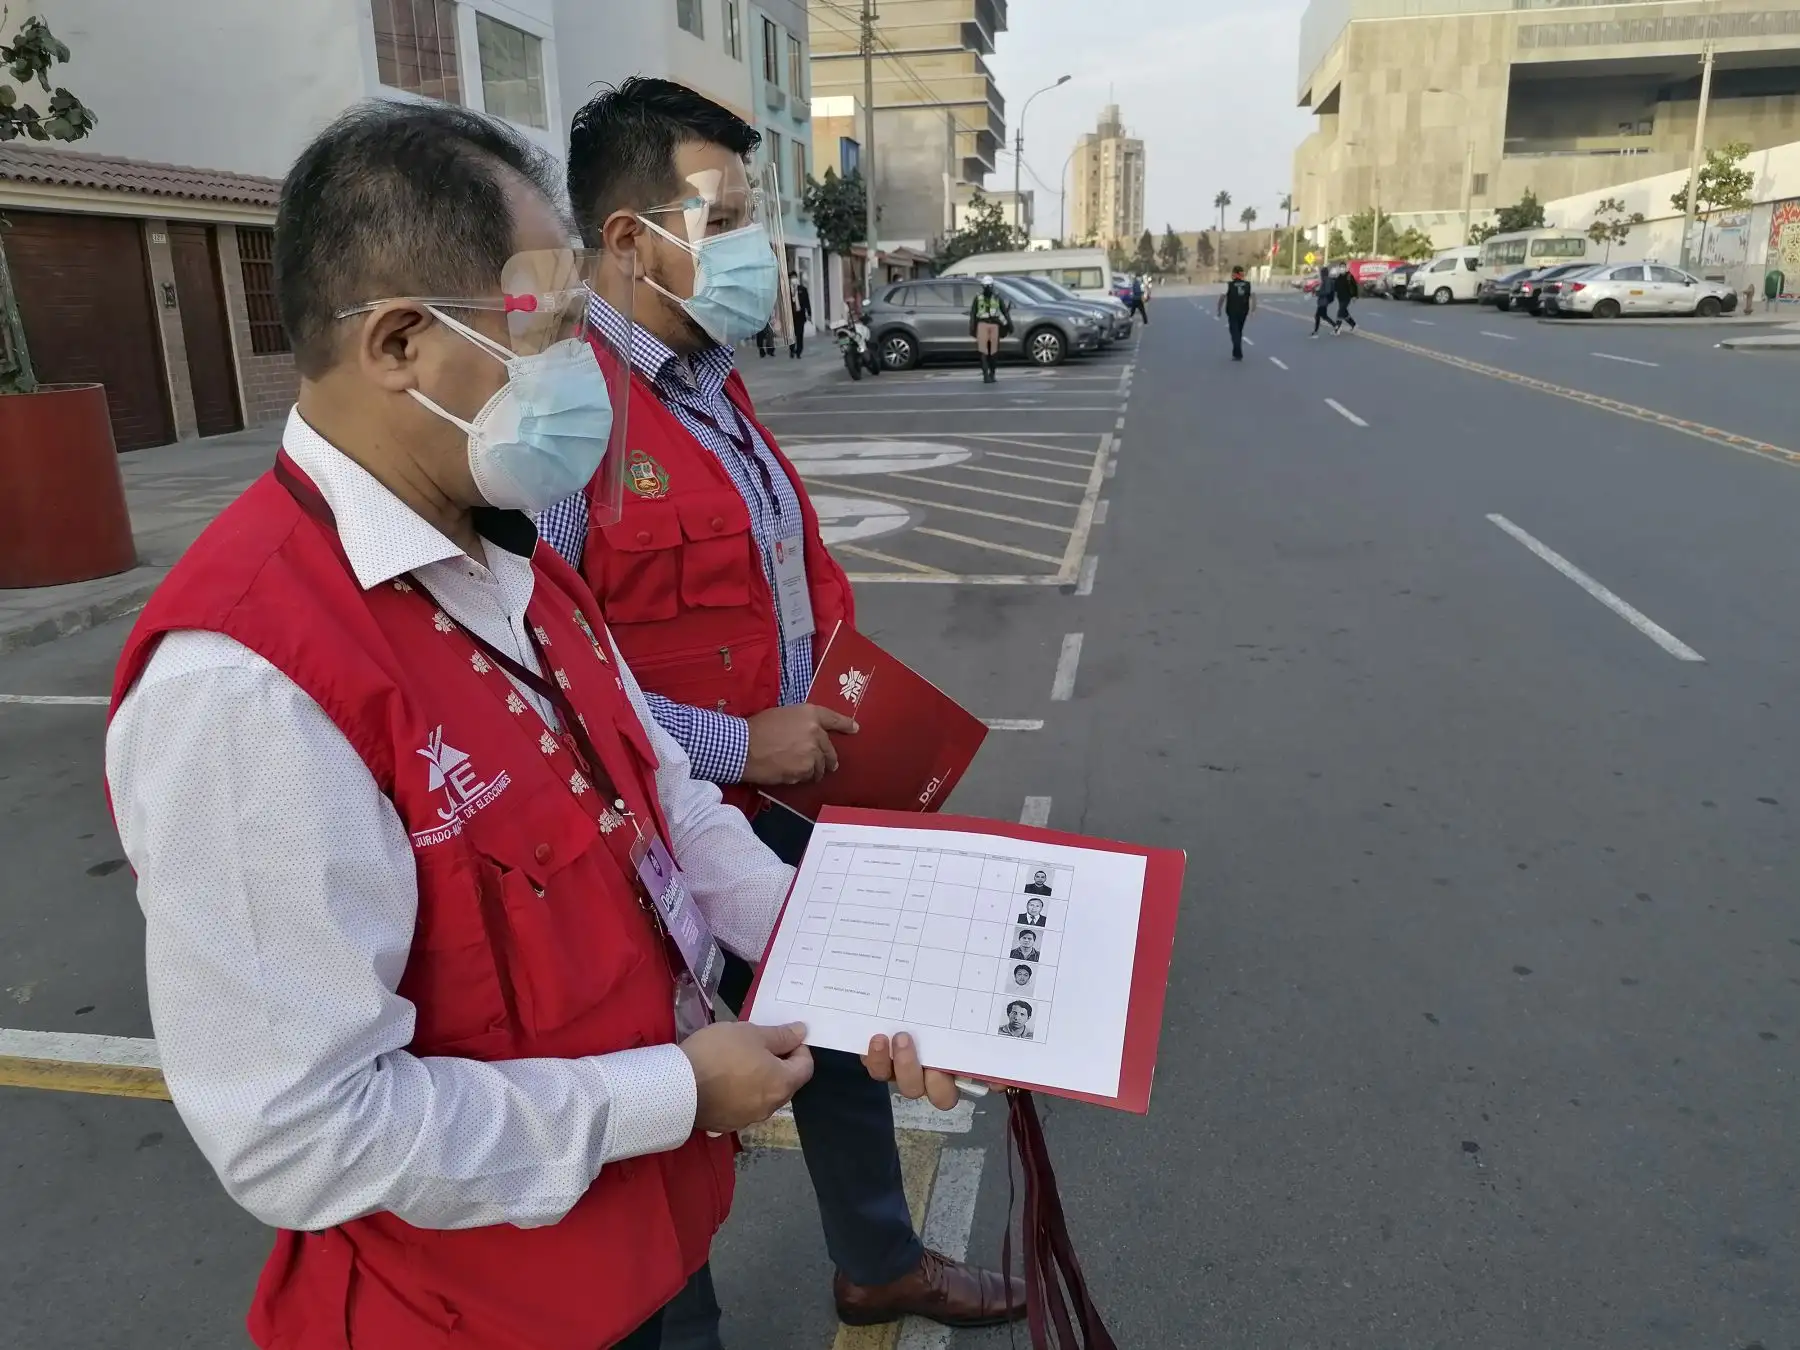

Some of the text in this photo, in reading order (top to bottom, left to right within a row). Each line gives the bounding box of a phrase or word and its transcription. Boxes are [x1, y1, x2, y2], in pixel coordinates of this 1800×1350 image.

[918, 776, 940, 804] DCI
[415, 773, 512, 848] JURADO DE ELECCIONES
[660, 876, 680, 912] Debate
